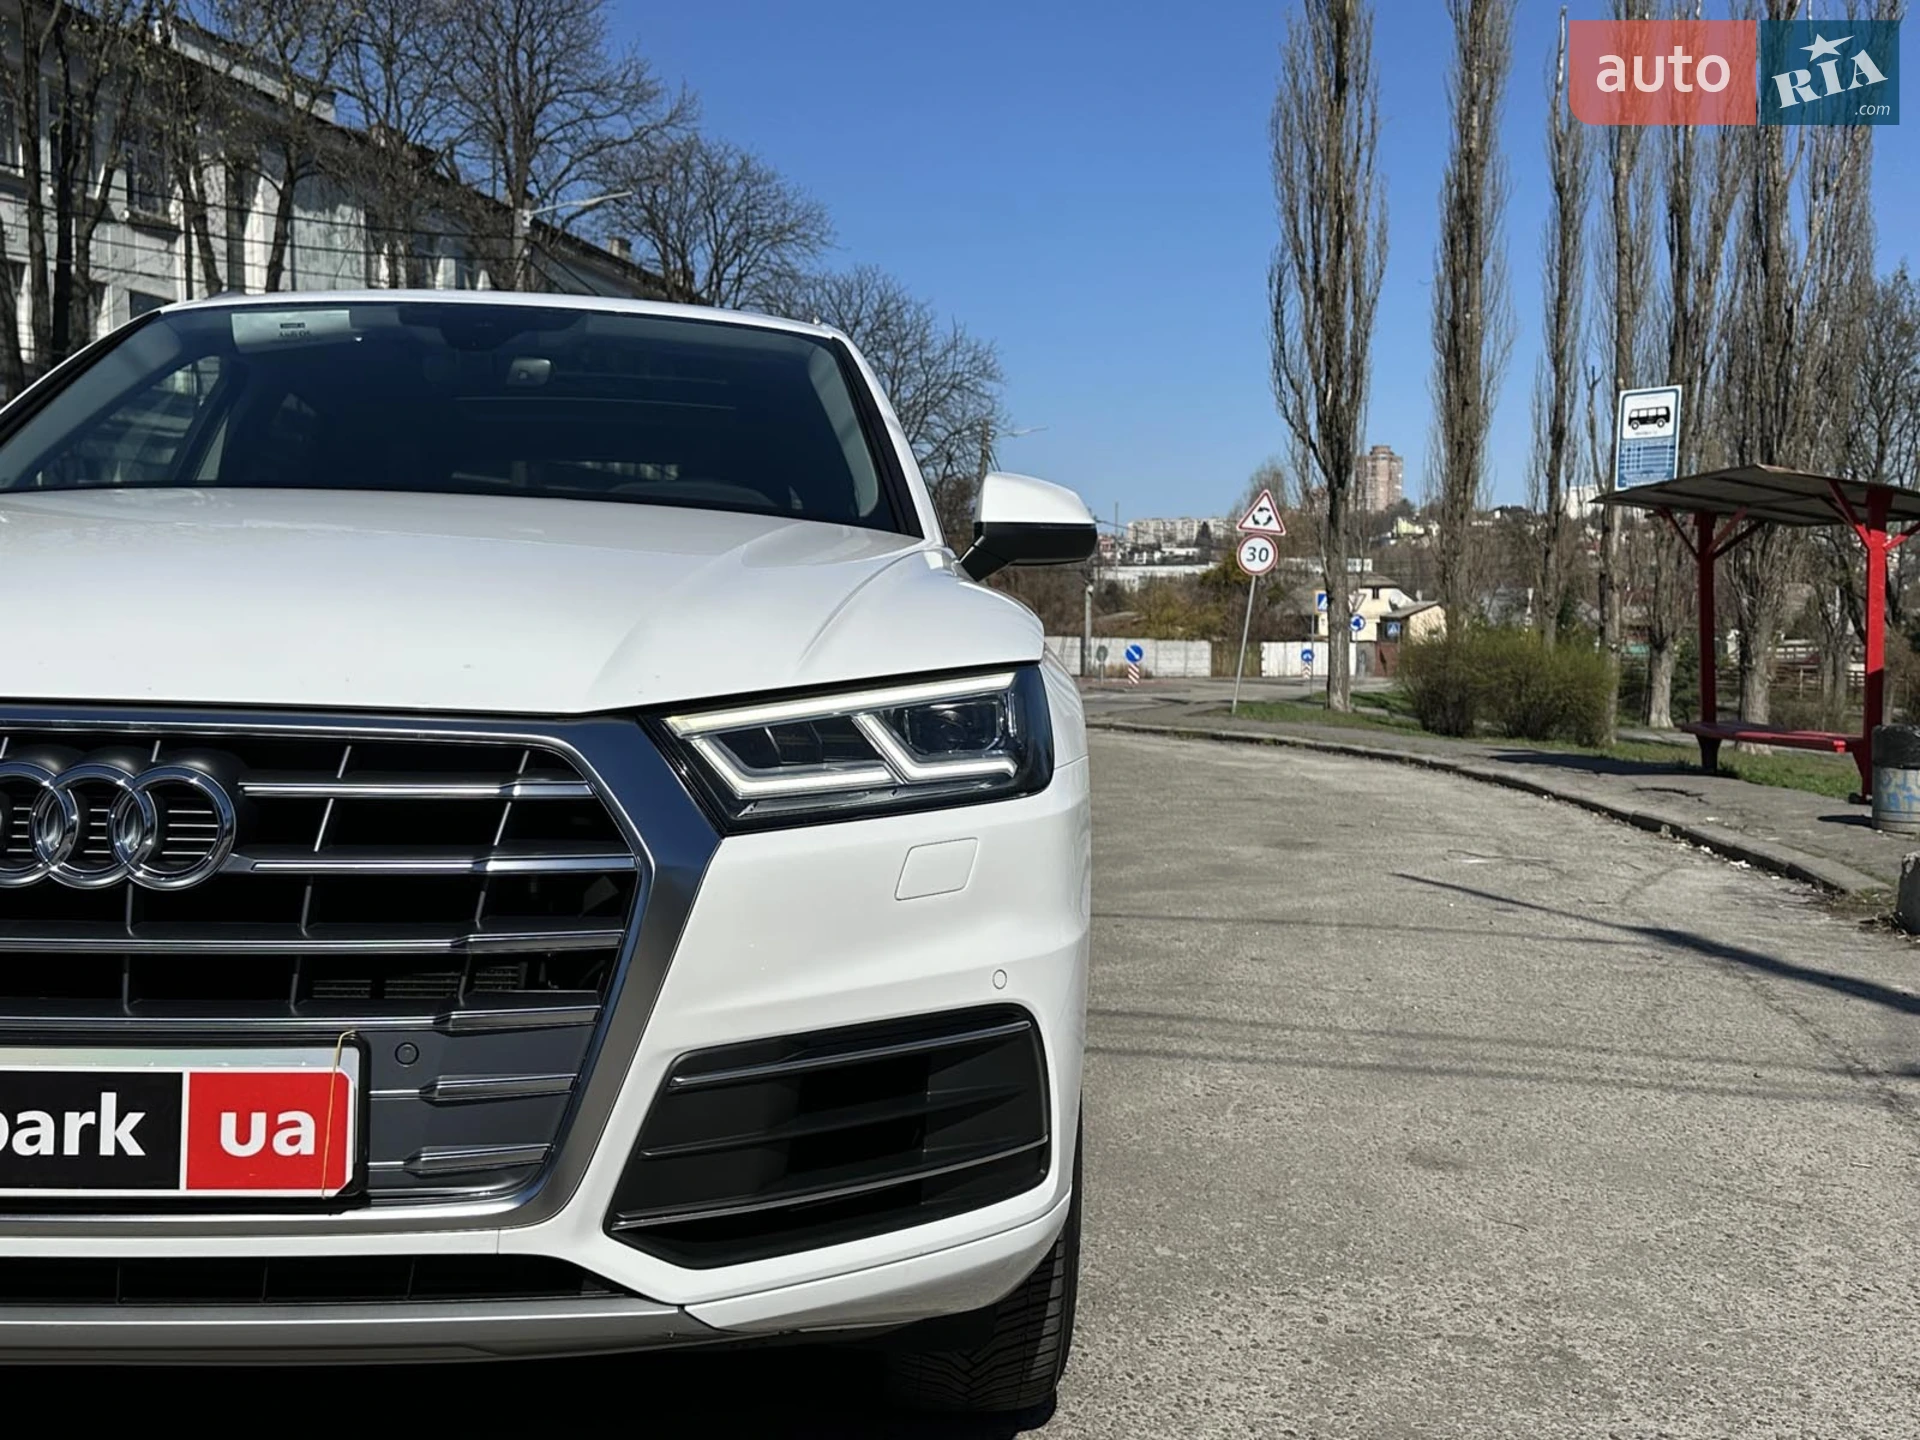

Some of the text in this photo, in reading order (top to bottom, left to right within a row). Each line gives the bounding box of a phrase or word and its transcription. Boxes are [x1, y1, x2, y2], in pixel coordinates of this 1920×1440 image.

[1246, 546, 1269, 563] 30
[0, 1092, 316, 1157] ark ua
